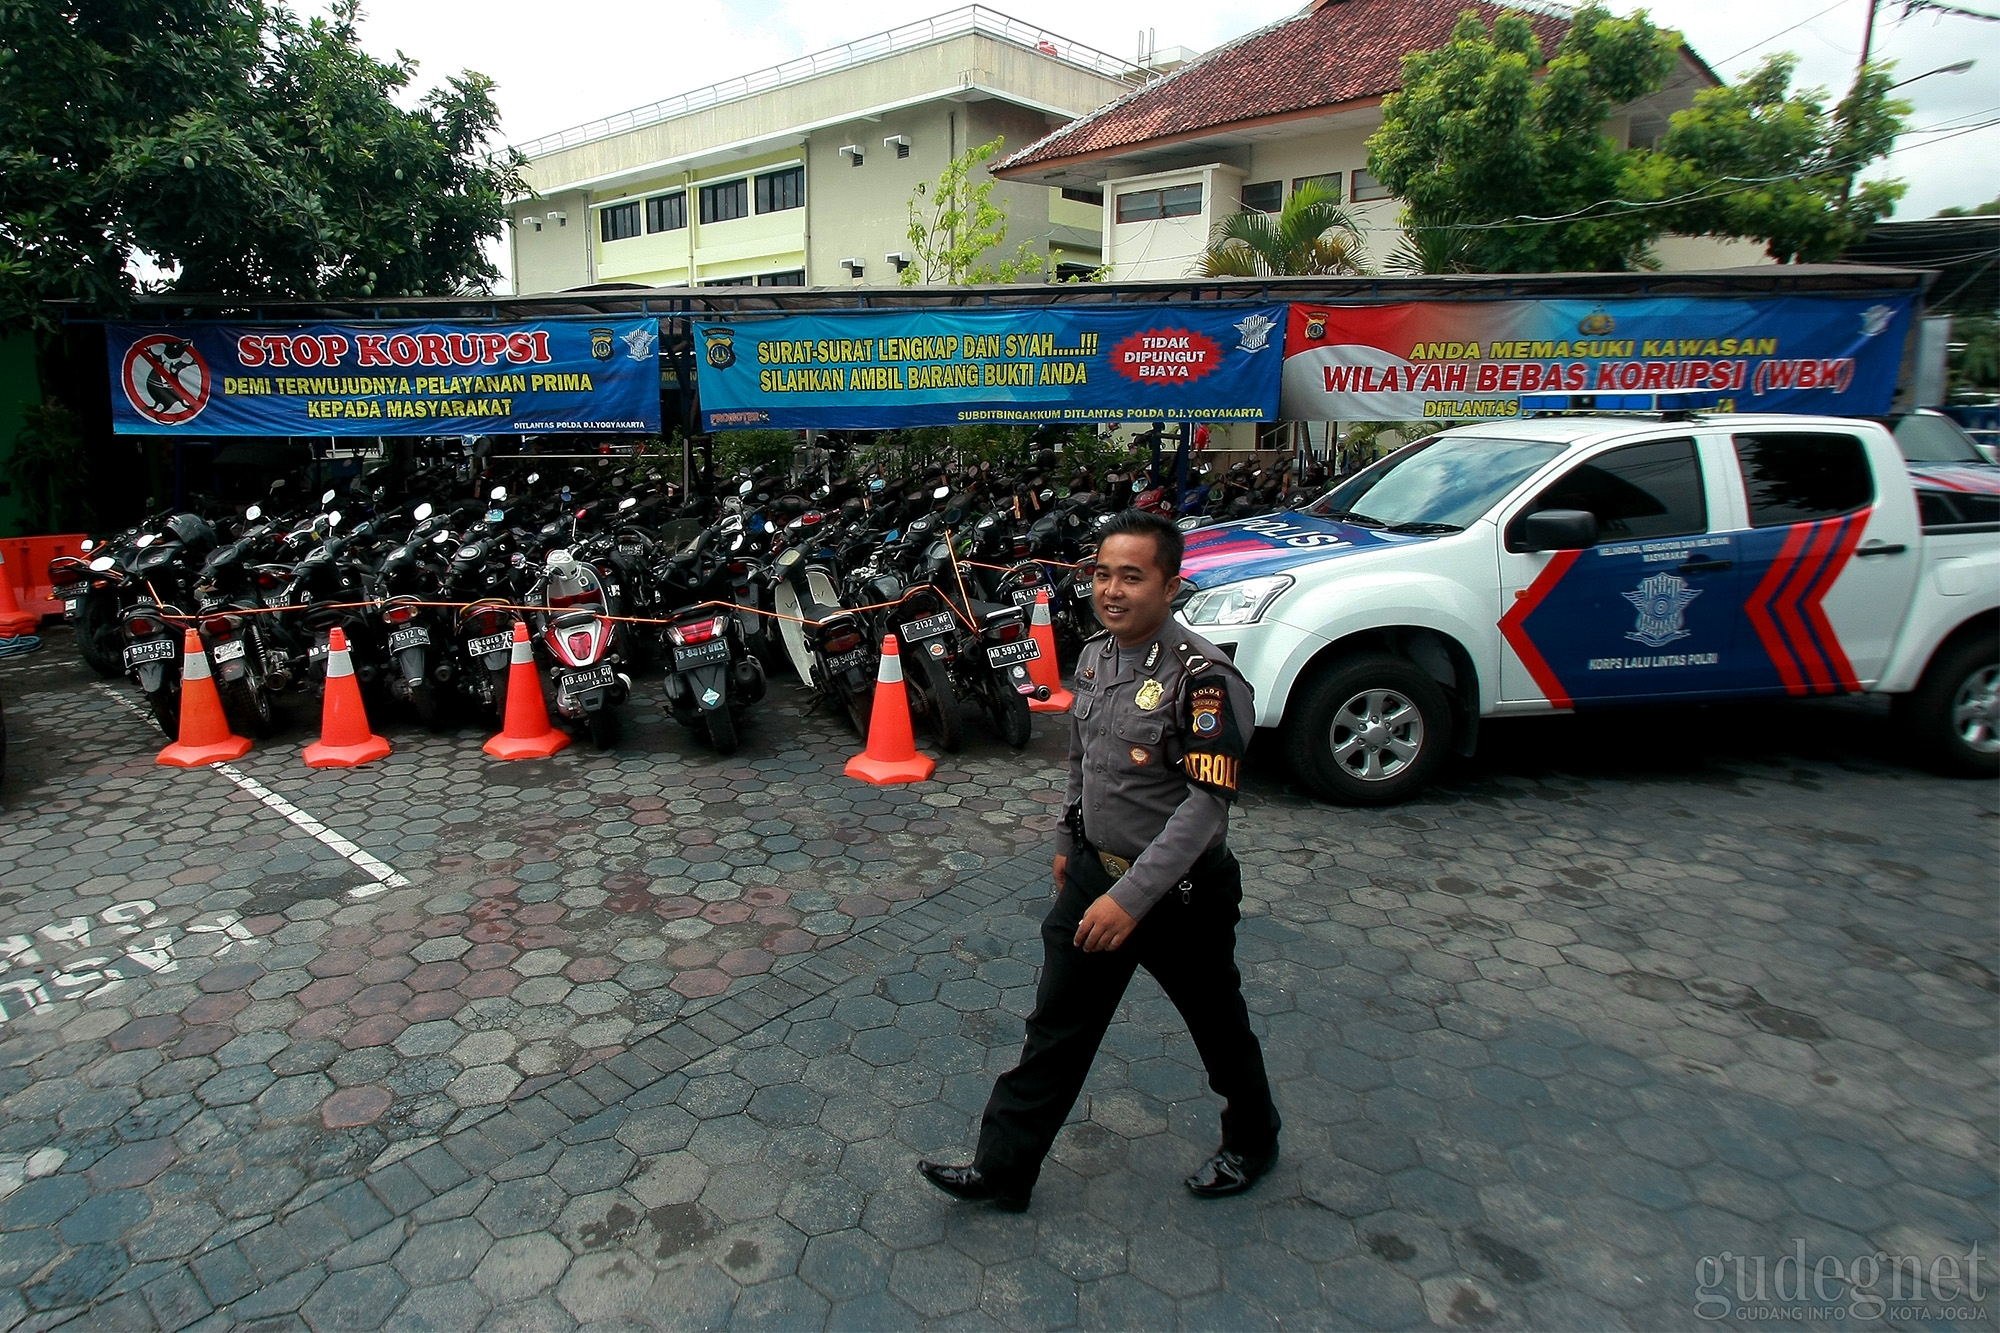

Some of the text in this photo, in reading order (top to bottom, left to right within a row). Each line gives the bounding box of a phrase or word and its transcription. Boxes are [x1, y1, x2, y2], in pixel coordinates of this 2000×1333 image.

[238, 331, 552, 366] STOP KORUPSI
[758, 339, 874, 364] SURAT-SURAT
[878, 335, 958, 361] LENGKAP
[963, 335, 1000, 359] DAN
[1142, 337, 1189, 348] TIDAK
[1409, 338, 1778, 360] ANDA MEMASUKI KAWASAN
[1124, 351, 1206, 363] DIPUNGUT
[760, 361, 1088, 392] SILAHKAN AMBIL BARANG BUKTI ANDA
[1139, 365, 1189, 377] BIAYA
[1322, 358, 1856, 396] WILAYAH BEBAS KORUPSI (WBK)
[224, 373, 593, 395] DEMI TERWUJUDNYA PELAYANAN PRIMA
[307, 399, 512, 418] KEPADA MASYARAKAT
[1064, 409, 1124, 419] DITLANTAS
[1127, 408, 1165, 418] POLDA
[1424, 400, 1518, 417] DITLANTAS
[514, 422, 554, 430] DITLANTAS
[1236, 519, 1353, 552] POLISI
[914, 619, 933, 630] 2132
[395, 629, 414, 642] 6512
[309, 646, 320, 657] AB
[1001, 644, 1021, 656] 5991
[1588, 653, 1718, 670] KORPS LALU LINTAS POLRI
[1192, 687, 1220, 698] POLDA
